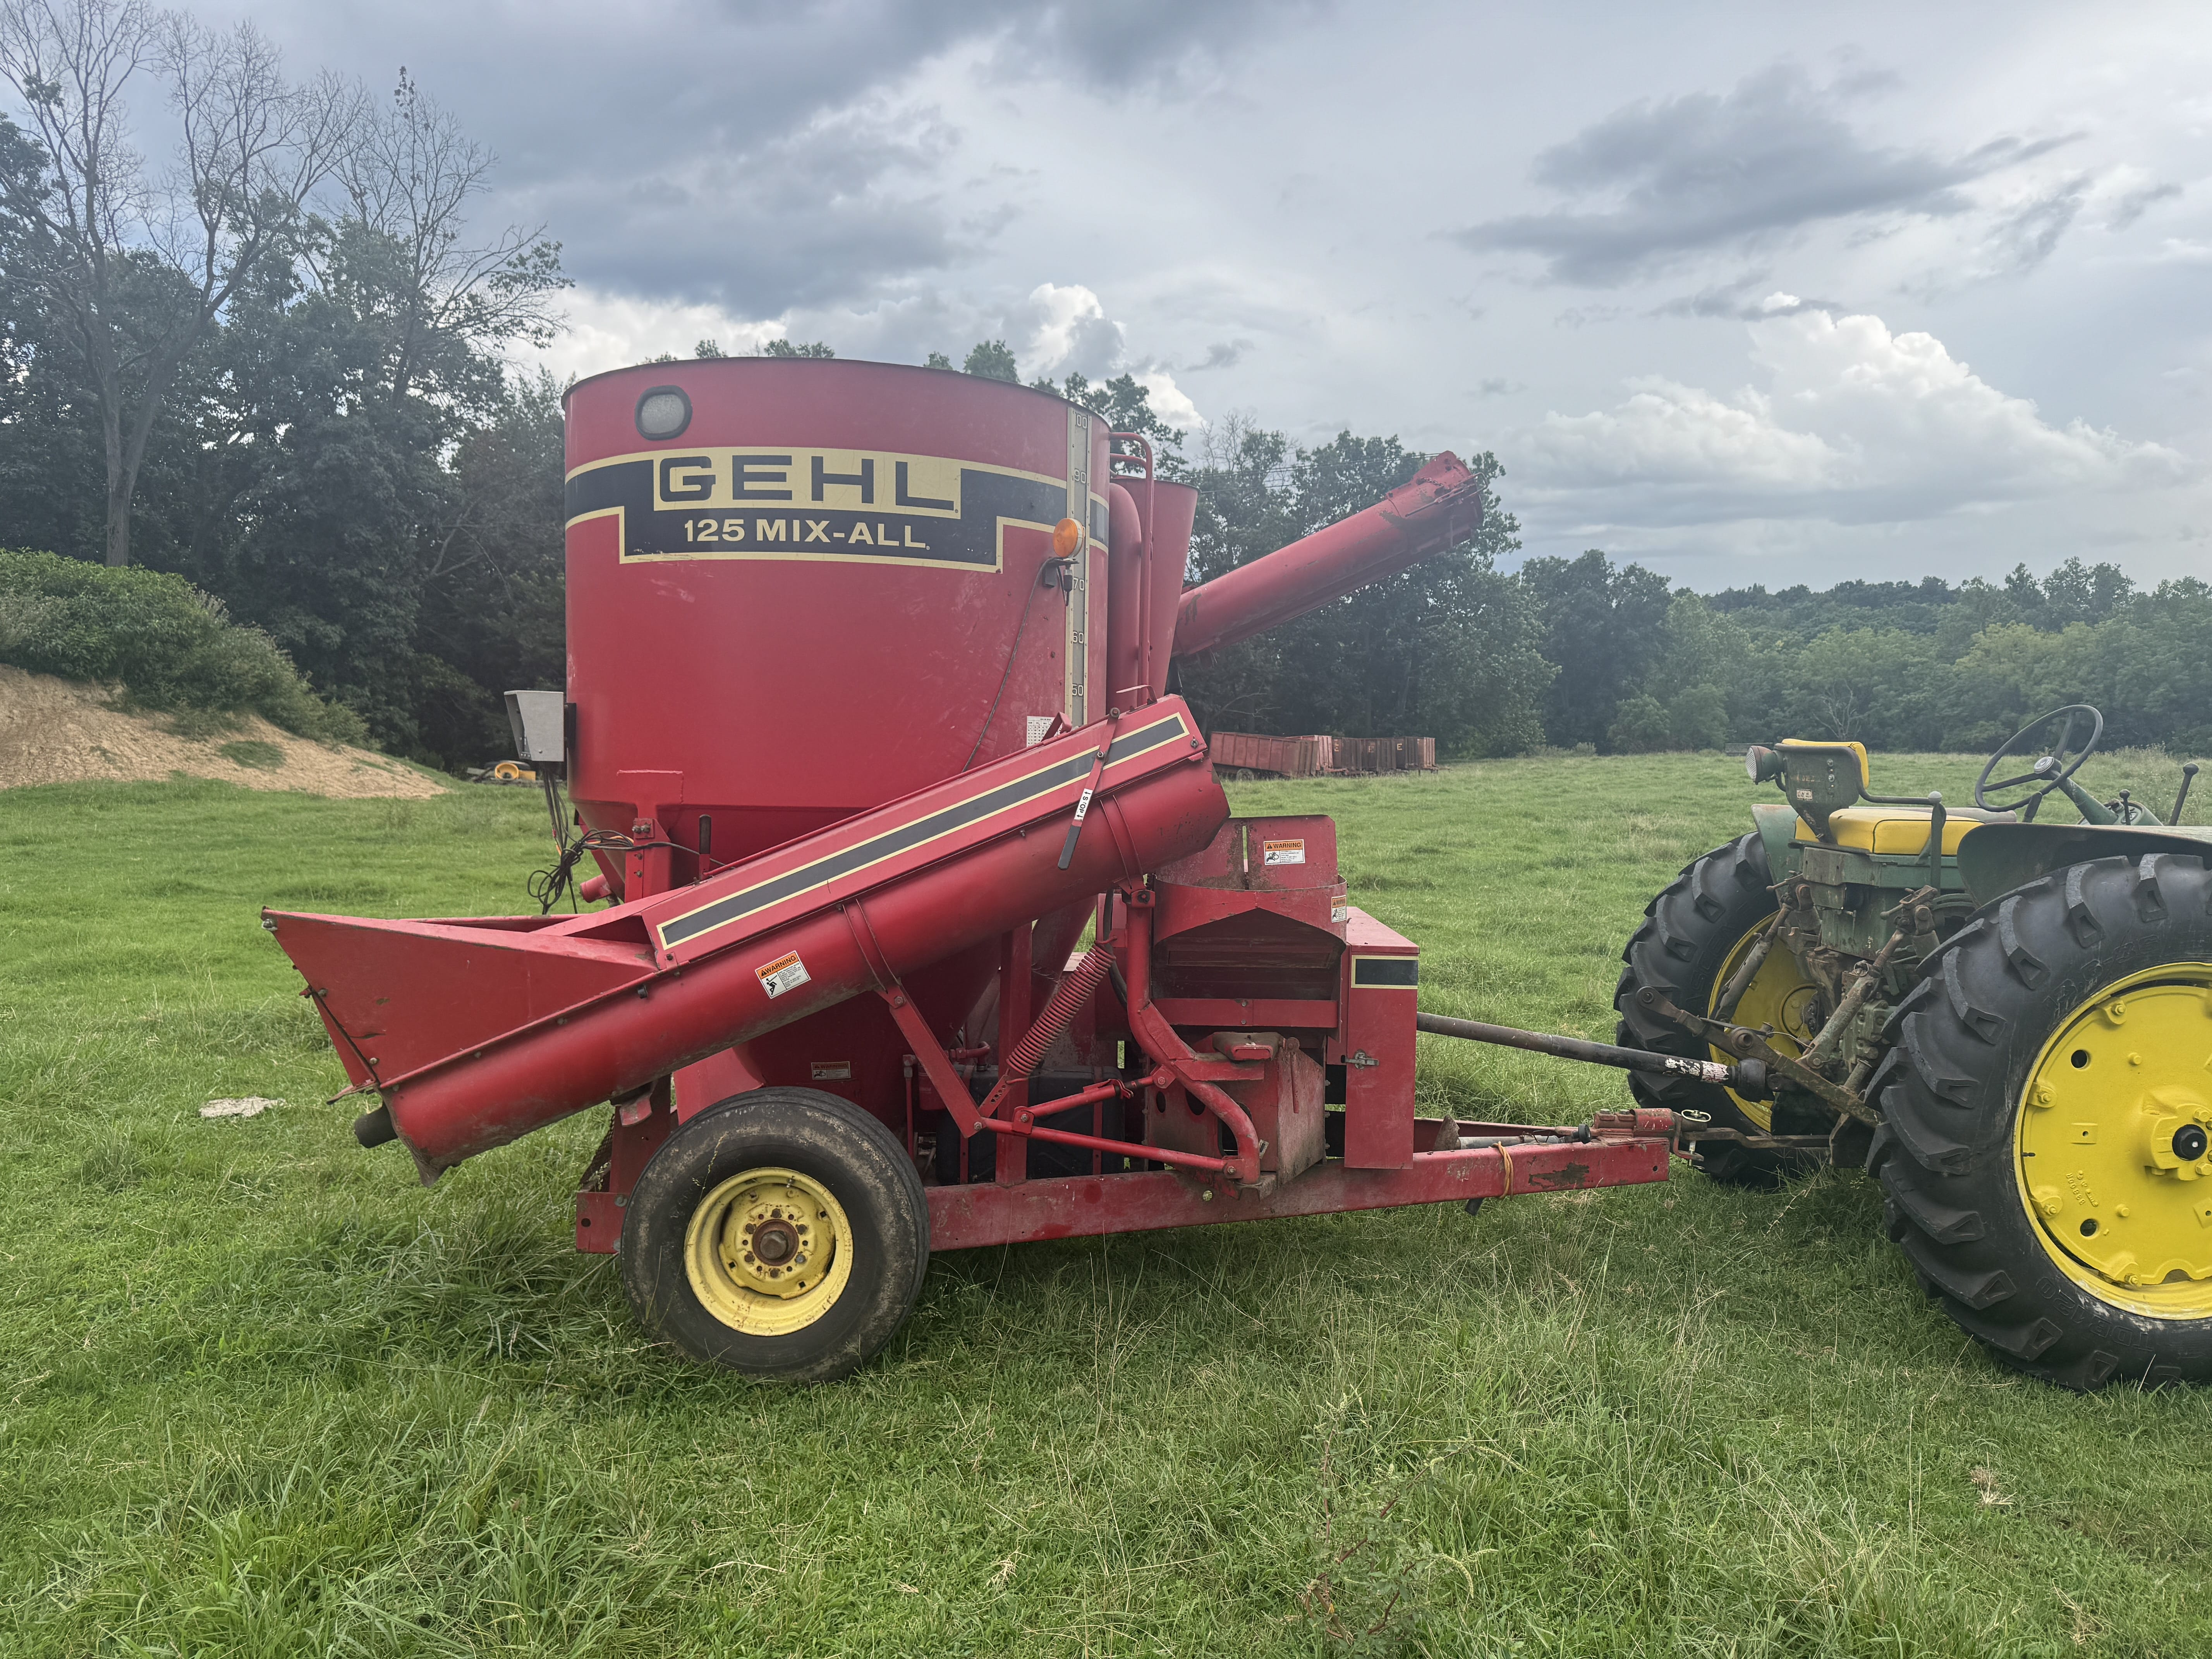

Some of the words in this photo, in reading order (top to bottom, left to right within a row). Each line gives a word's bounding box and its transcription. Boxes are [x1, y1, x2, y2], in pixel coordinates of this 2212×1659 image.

[1075, 414, 1087, 429] 00
[659, 455, 954, 510] GEHL
[1074, 469, 1086, 483] 90
[685, 519, 744, 542] 125
[757, 519, 926, 548] MIX-ALL
[1073, 577, 1084, 591] 70
[1073, 631, 1084, 644] 60
[765, 955, 796, 973] WARNING
